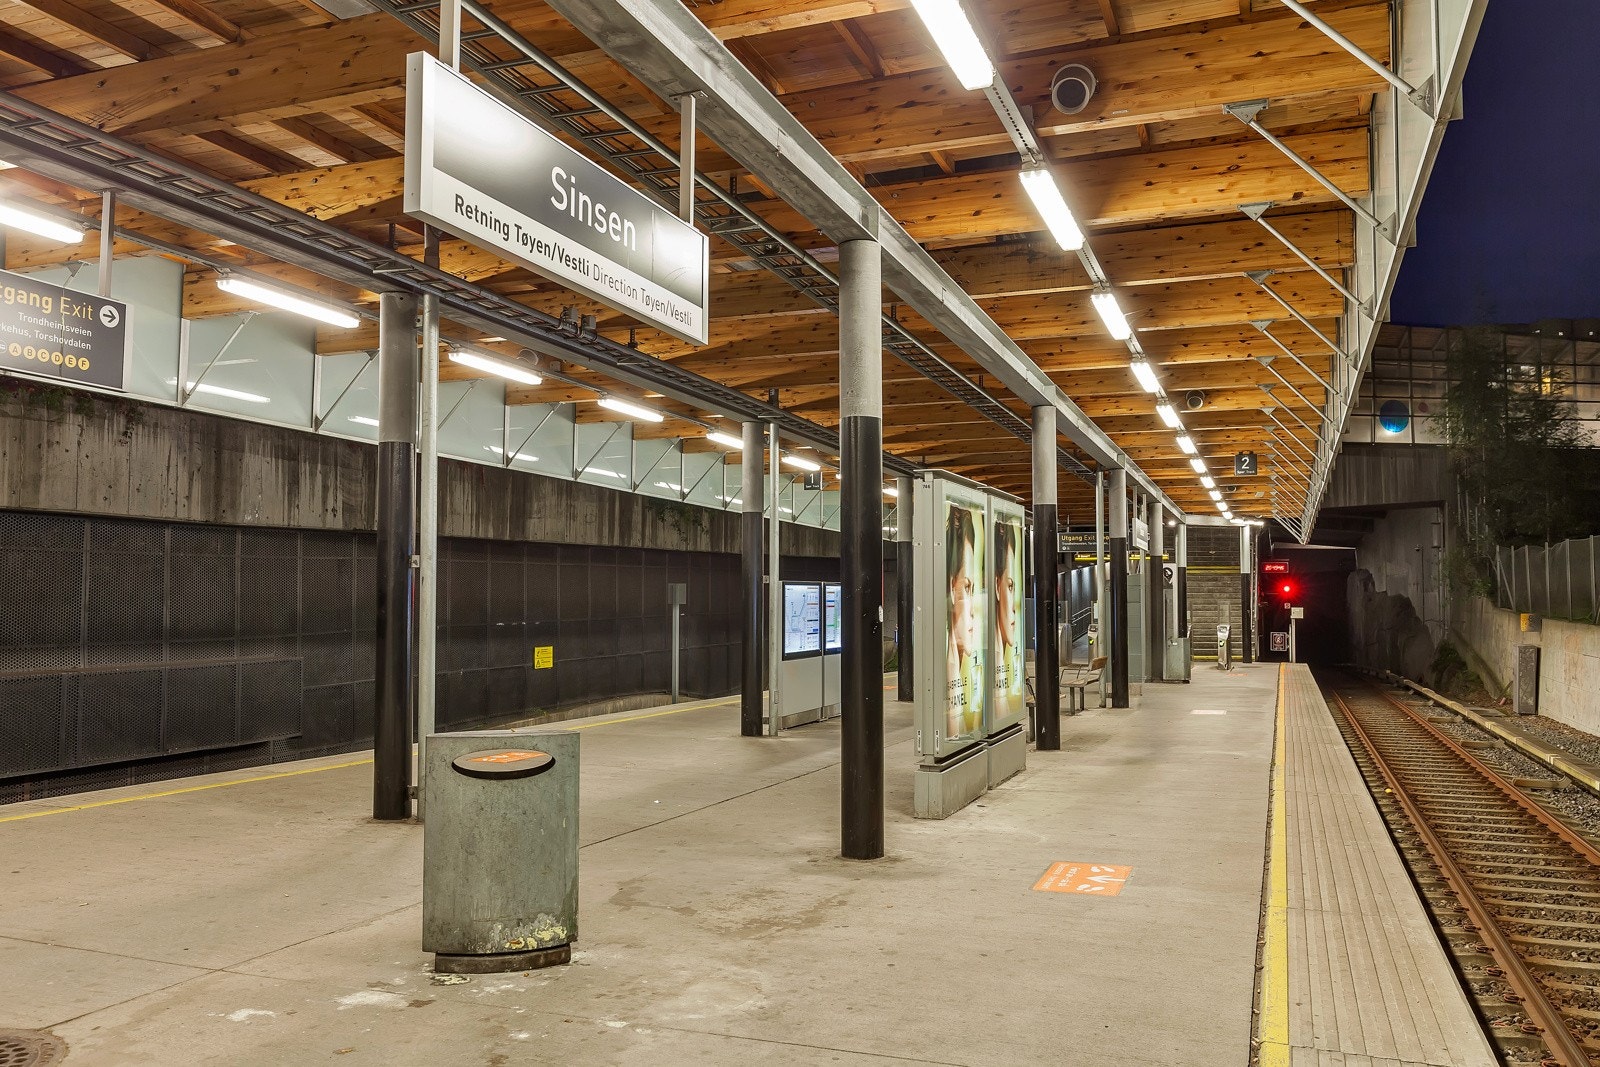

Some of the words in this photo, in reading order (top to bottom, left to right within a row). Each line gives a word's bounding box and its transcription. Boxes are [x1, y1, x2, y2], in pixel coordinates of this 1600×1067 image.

[550, 165, 637, 252] Sinsen
[454, 192, 510, 242] Retning
[514, 223, 590, 277] Tøyen/Vestli
[593, 262, 639, 301] Direction
[640, 287, 693, 327] Tøyen/Vestli
[59, 296, 94, 321] Exit
[18, 311, 92, 338] Trondheimsveien
[34, 329, 92, 351] Torshovdalen
[1241, 456, 1250, 470] 2
[809, 473, 814, 484] 1
